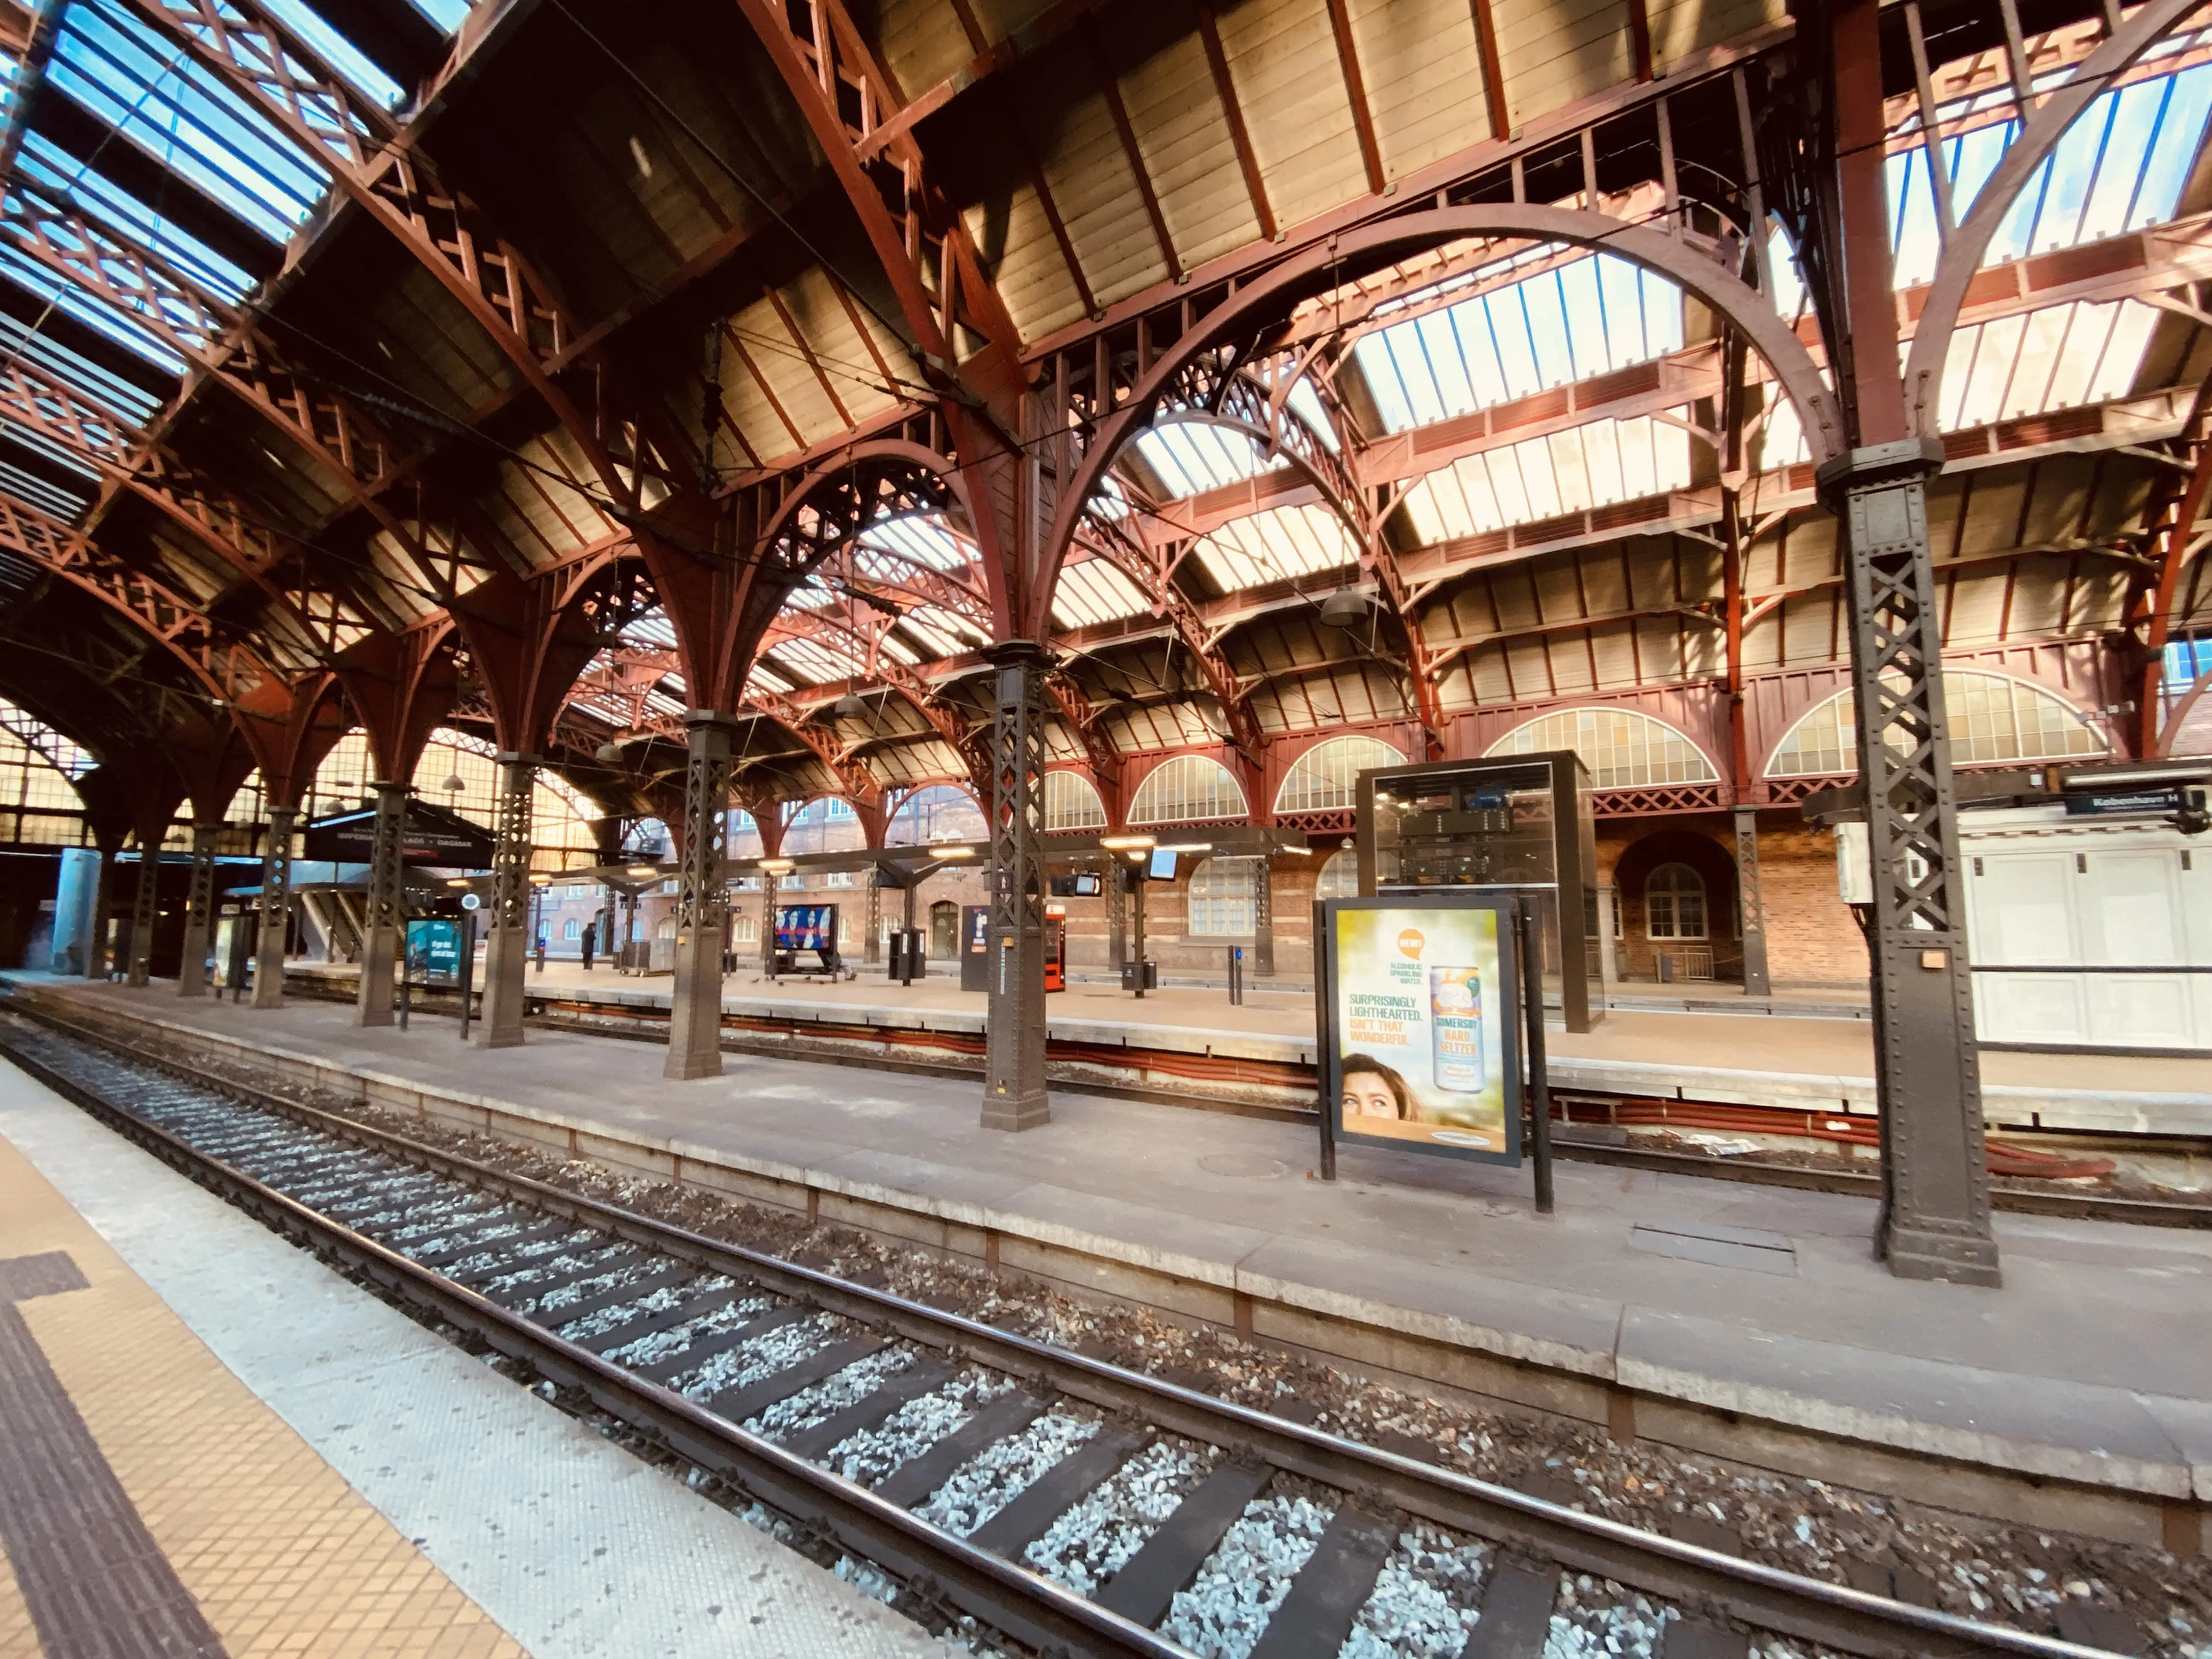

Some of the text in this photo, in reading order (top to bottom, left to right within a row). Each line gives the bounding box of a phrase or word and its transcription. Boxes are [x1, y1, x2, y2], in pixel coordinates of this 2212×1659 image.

[2168, 794, 2179, 802] H
[1400, 938, 1421, 948] NEW!
[1350, 994, 1417, 1008] SURPRISINGLY
[1350, 1006, 1423, 1021] LIGHTHEARTED.
[1350, 1019, 1404, 1032] ISN'T THAT
[1436, 1017, 1477, 1029] SOMERSBY
[1350, 1031, 1413, 1046] WONDERFUL.
[1444, 1029, 1470, 1042] HARD
[1440, 1042, 1476, 1055] SELTZER
